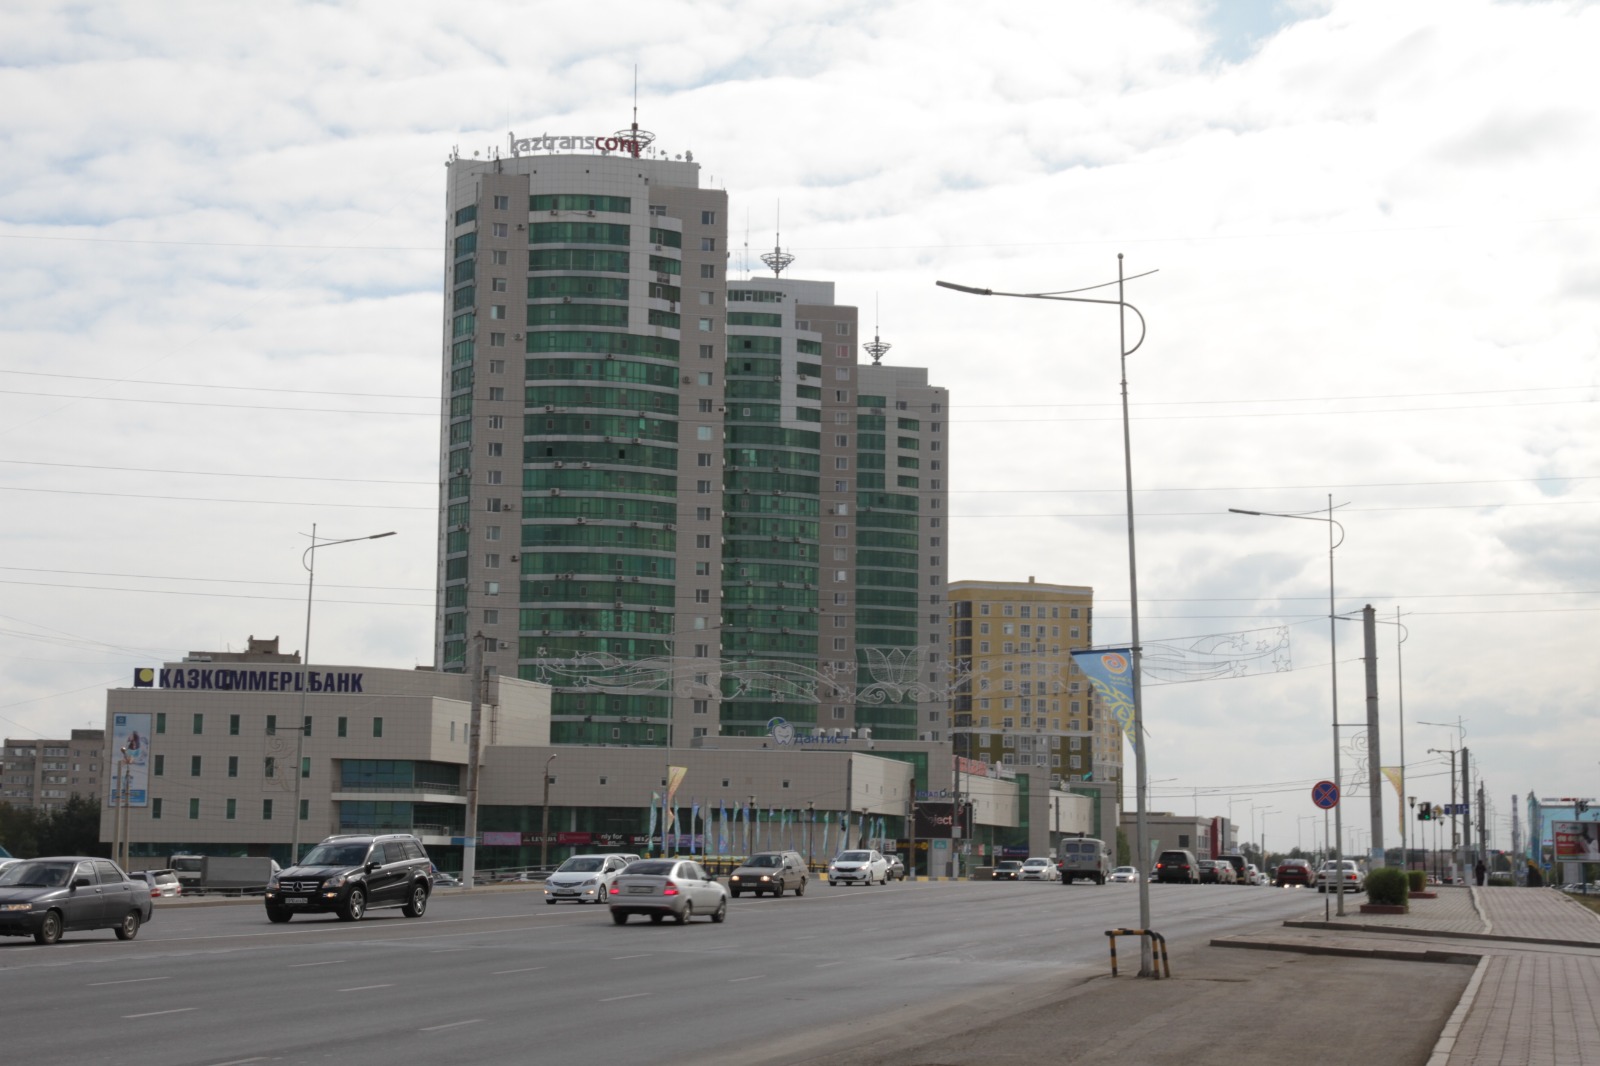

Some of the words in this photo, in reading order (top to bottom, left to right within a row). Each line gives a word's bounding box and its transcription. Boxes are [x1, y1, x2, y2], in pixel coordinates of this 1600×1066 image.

[508, 131, 641, 158] kaztranscom
[159, 668, 364, 693] КАЗКОММЕРЦБАНК
[794, 732, 849, 745] Дантист
